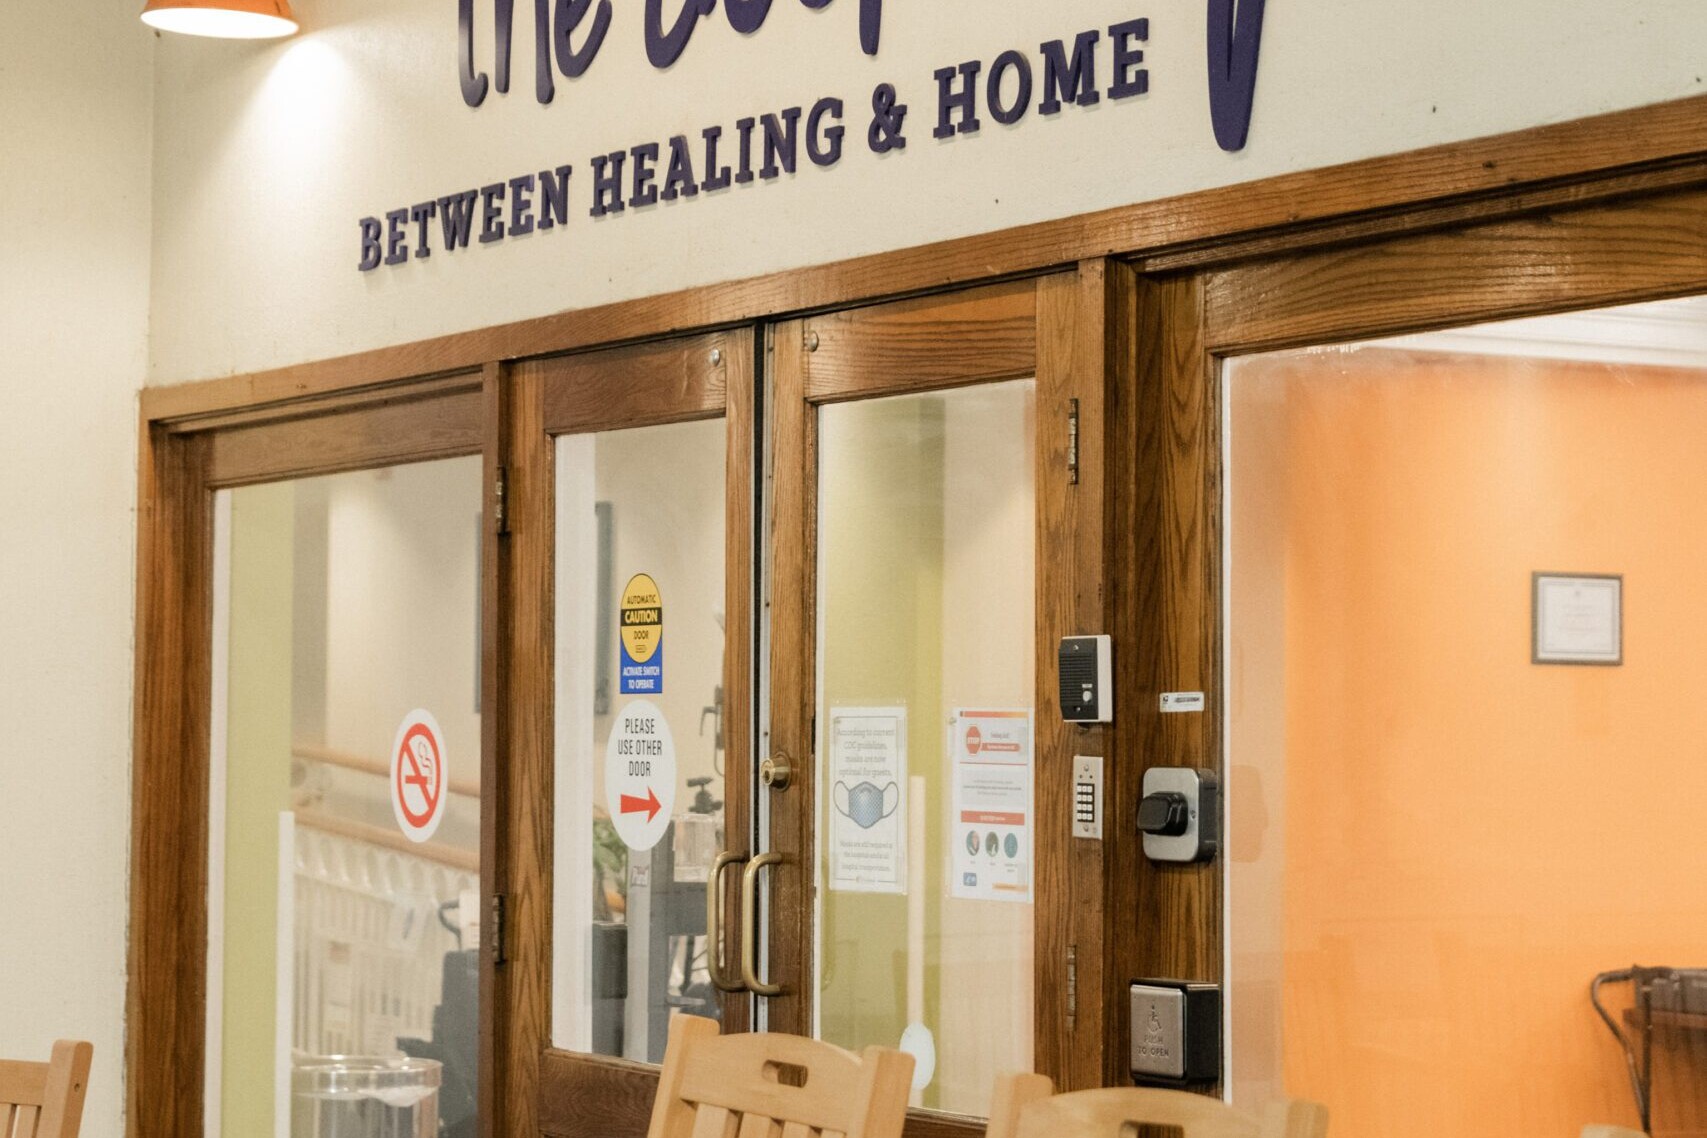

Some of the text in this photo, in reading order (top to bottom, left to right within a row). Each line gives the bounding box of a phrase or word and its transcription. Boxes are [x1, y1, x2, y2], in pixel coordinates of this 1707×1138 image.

[357, 165, 572, 272] BETWEEN
[589, 97, 846, 217] HEALING
[867, 82, 907, 154] &
[933, 17, 1150, 139] HOME
[626, 594, 656, 604] AUTOMATIC
[625, 609, 658, 623] CAUTION
[633, 630, 649, 640] DOOR
[628, 679, 635, 689] TO
[625, 718, 655, 734] PLEASE
[618, 739, 662, 755] USE OTHER
[629, 761, 651, 777] DOOR
[1137, 1046, 1170, 1057] TO OPEN
